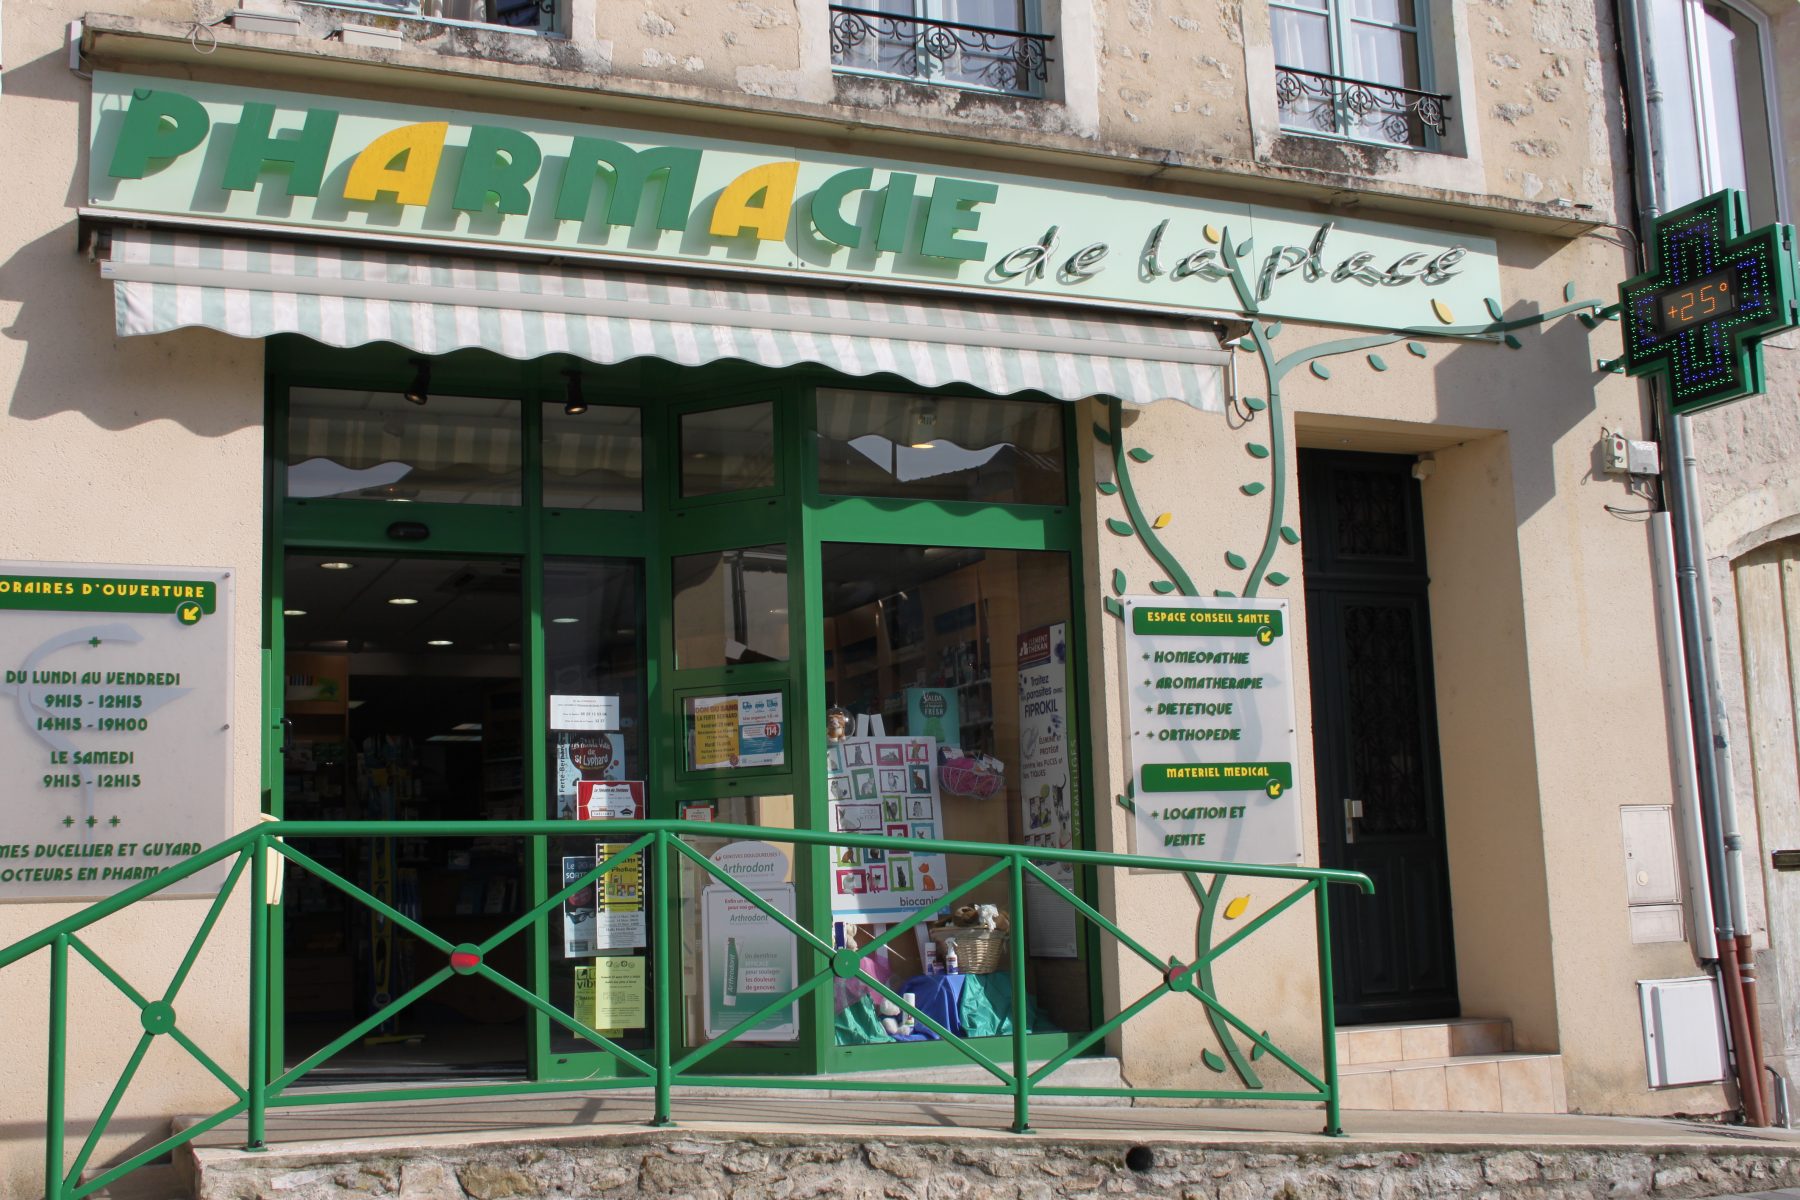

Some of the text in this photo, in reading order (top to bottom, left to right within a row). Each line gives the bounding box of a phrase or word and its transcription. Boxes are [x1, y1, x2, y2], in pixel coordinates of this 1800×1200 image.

[108, 88, 1469, 302] PHARMACIE de la place
[0, 581, 205, 598] ORAIRES D'OUVERTURE
[1147, 611, 1270, 624] ESPACE CONSEIL SANTE
[1154, 651, 1250, 665] HOMEOPATHIE
[6, 670, 181, 686] DU LUNDI AU VENDREDI
[1155, 677, 1263, 689] AROMATHERAPIE
[44, 694, 83, 709] 9H15
[98, 694, 143, 709] 12H15
[1026, 687, 1051, 702] parasites
[1024, 698, 1058, 718] FIPROKIL
[1157, 702, 1233, 716] DIETETIQUE
[37, 717, 83, 732] 14H15
[98, 718, 148, 732] 19H00
[765, 726, 777, 736] 114
[1158, 728, 1242, 742] ORTHOPEDIE
[50, 751, 135, 765] LE SAMEDI
[583, 753, 609, 766] Lyphard
[1166, 766, 1269, 777] MATERIEL MEDICAL
[43, 774, 81, 789] 9H15
[97, 774, 142, 788] 12H15
[1163, 806, 1246, 820] LOCATION ET
[1164, 833, 1206, 846] VENTE
[34, 843, 114, 858] DUCELLIER
[117, 843, 138, 857] ET
[143, 842, 202, 857] GUYARD
[1, 866, 188, 882] OCTEURS EN PHARM
[722, 861, 774, 873] Arthrodont
[899, 896, 938, 906] biocani
[729, 914, 768, 922] Arthrodont
